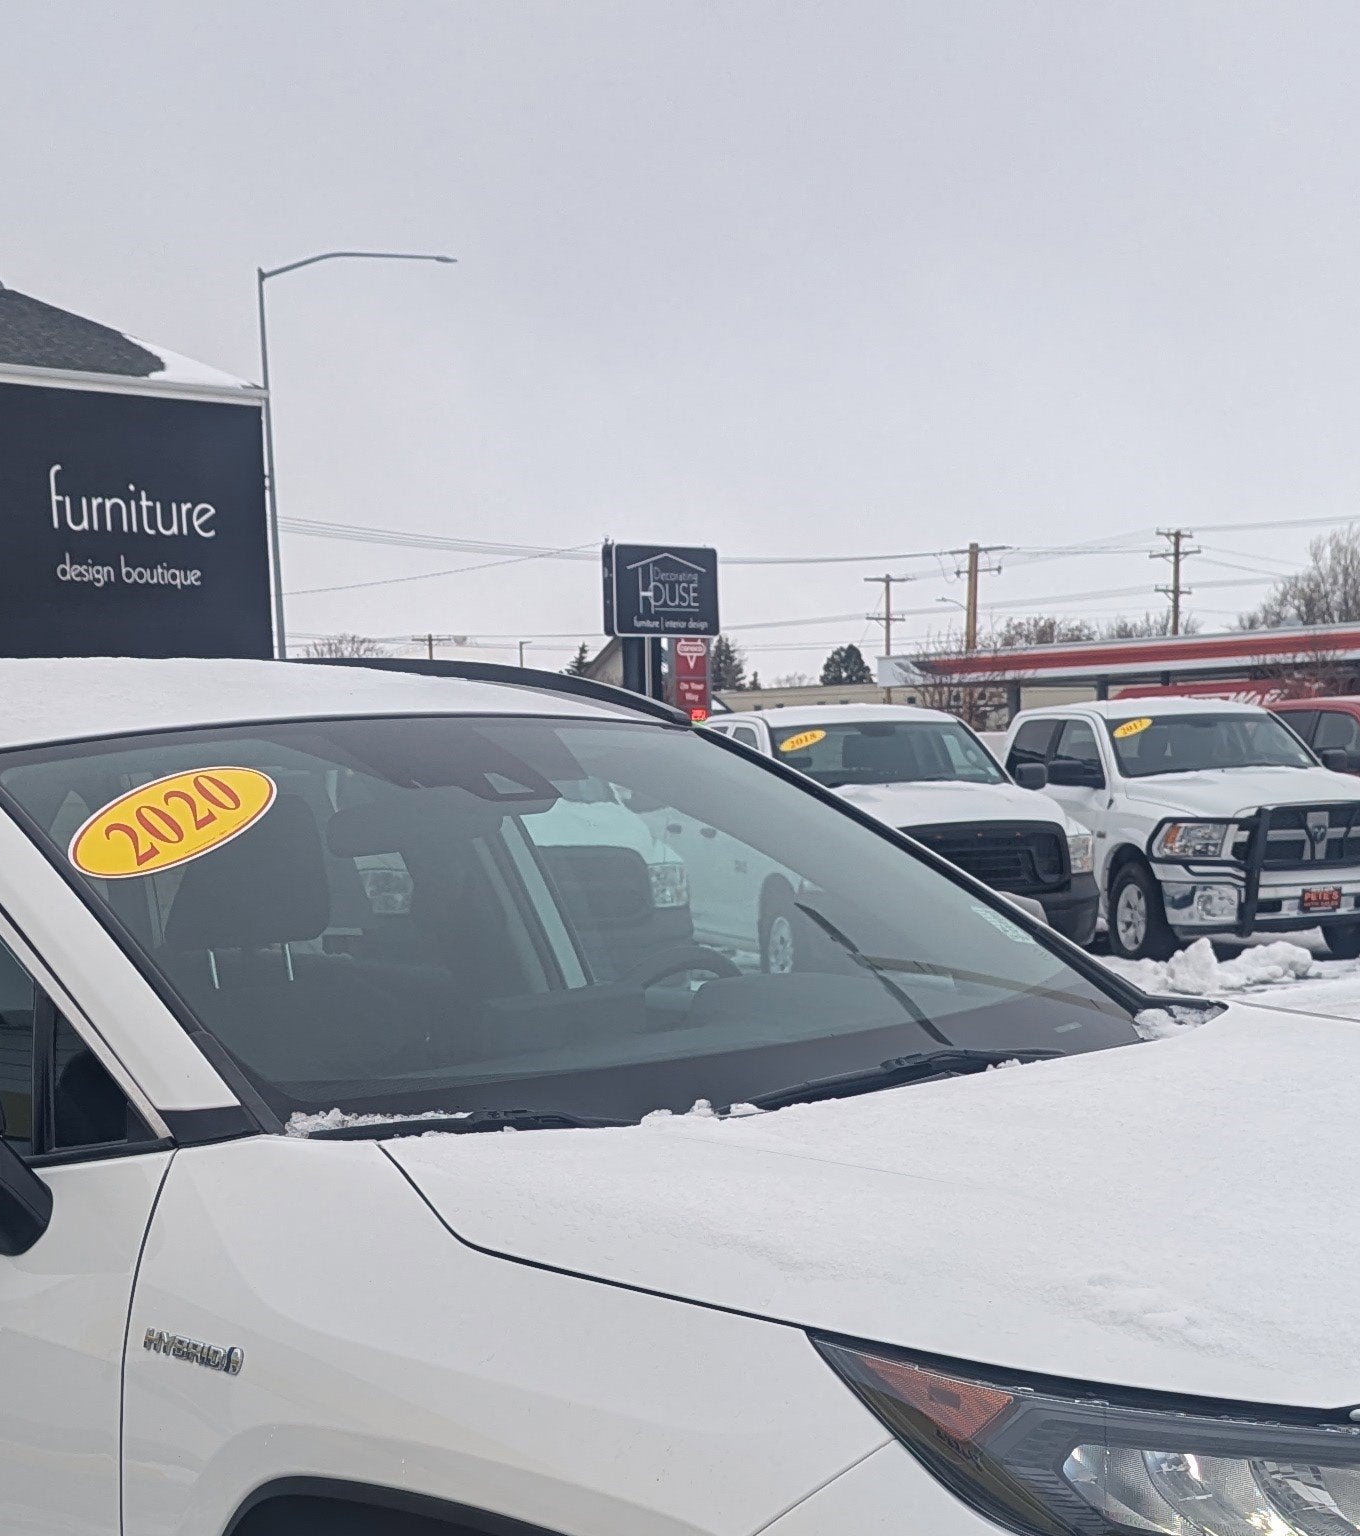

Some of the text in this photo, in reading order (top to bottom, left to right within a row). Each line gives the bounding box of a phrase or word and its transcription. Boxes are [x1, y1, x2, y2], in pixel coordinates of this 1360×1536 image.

[49, 464, 216, 538] furniture
[56, 552, 202, 590] design boutique
[638, 563, 700, 614] HOUSE
[105, 775, 241, 867] 2020
[143, 1328, 227, 1371] HYBRID
